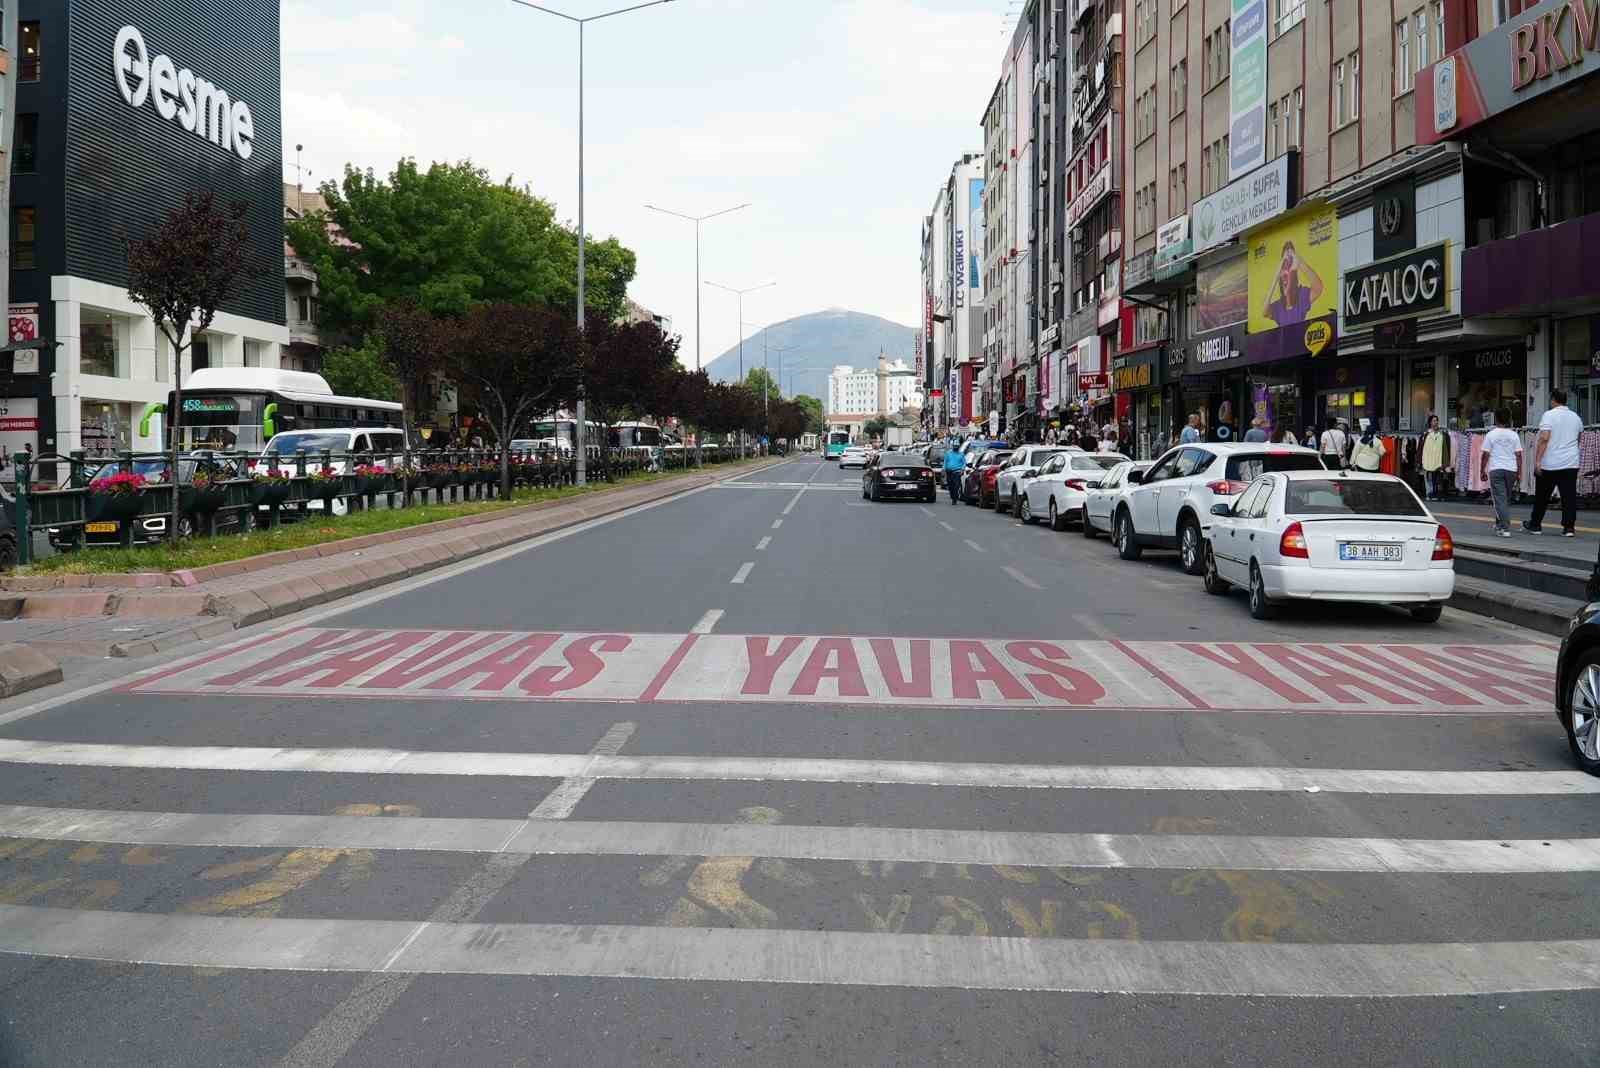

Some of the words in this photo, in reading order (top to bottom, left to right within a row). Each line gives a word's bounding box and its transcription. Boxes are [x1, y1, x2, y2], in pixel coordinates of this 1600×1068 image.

[1253, 169, 1280, 198] SUFFA
[956, 289, 965, 309] LC
[1345, 258, 1440, 317] KATALOG
[1475, 349, 1512, 368] KATALOG
[183, 399, 200, 411] 458
[1361, 546, 1379, 557] AAH
[1383, 546, 1400, 557] 083
[208, 630, 632, 696] YAVAŞ
[740, 635, 1107, 705] YAVAŞ
